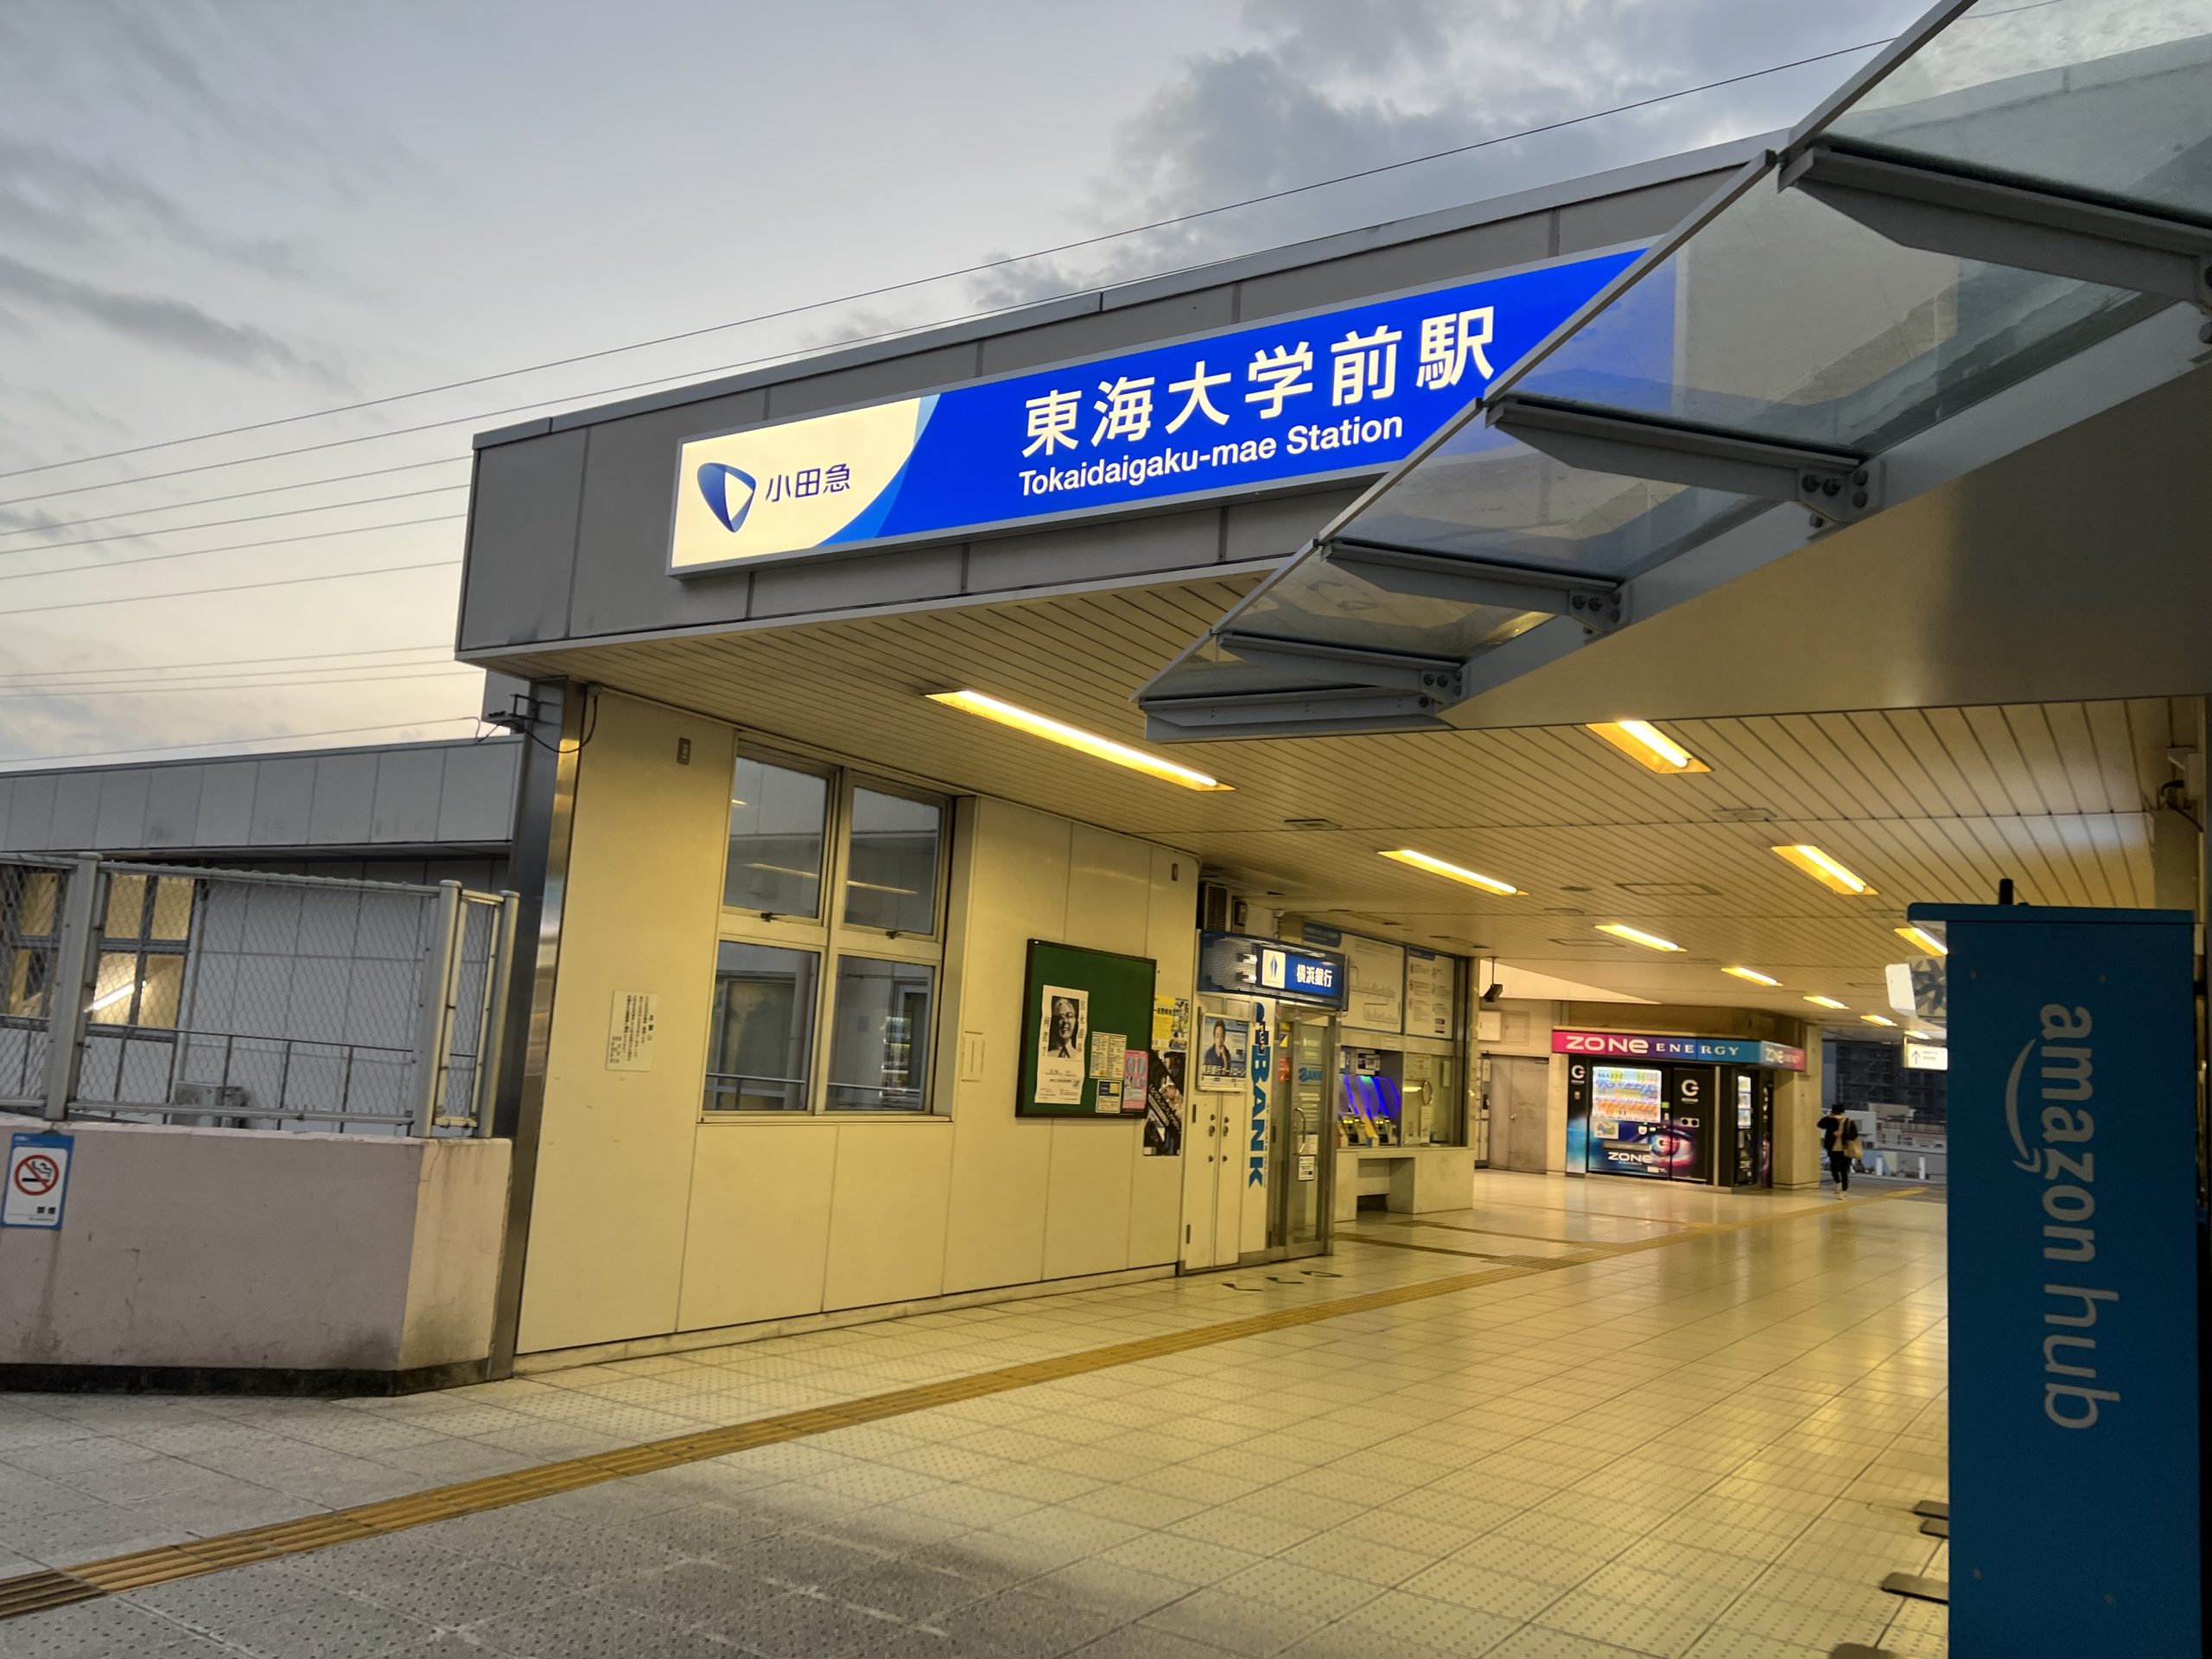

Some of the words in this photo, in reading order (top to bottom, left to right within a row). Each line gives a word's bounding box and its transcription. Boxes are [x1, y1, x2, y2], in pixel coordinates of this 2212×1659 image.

[1020, 305, 1495, 460] 東海大学前駅
[766, 463, 852, 503] 小田急
[1018, 437, 1279, 497] Tokaidaigaku-mae
[1284, 415, 1404, 455] Station
[1296, 962, 1333, 988] 横浜銀行
[1655, 1042, 1740, 1056] ENERGY
[1248, 1044, 1271, 1189] BANK
[2039, 1002, 2097, 1263] amazon
[2042, 1282, 2120, 1431] hub
